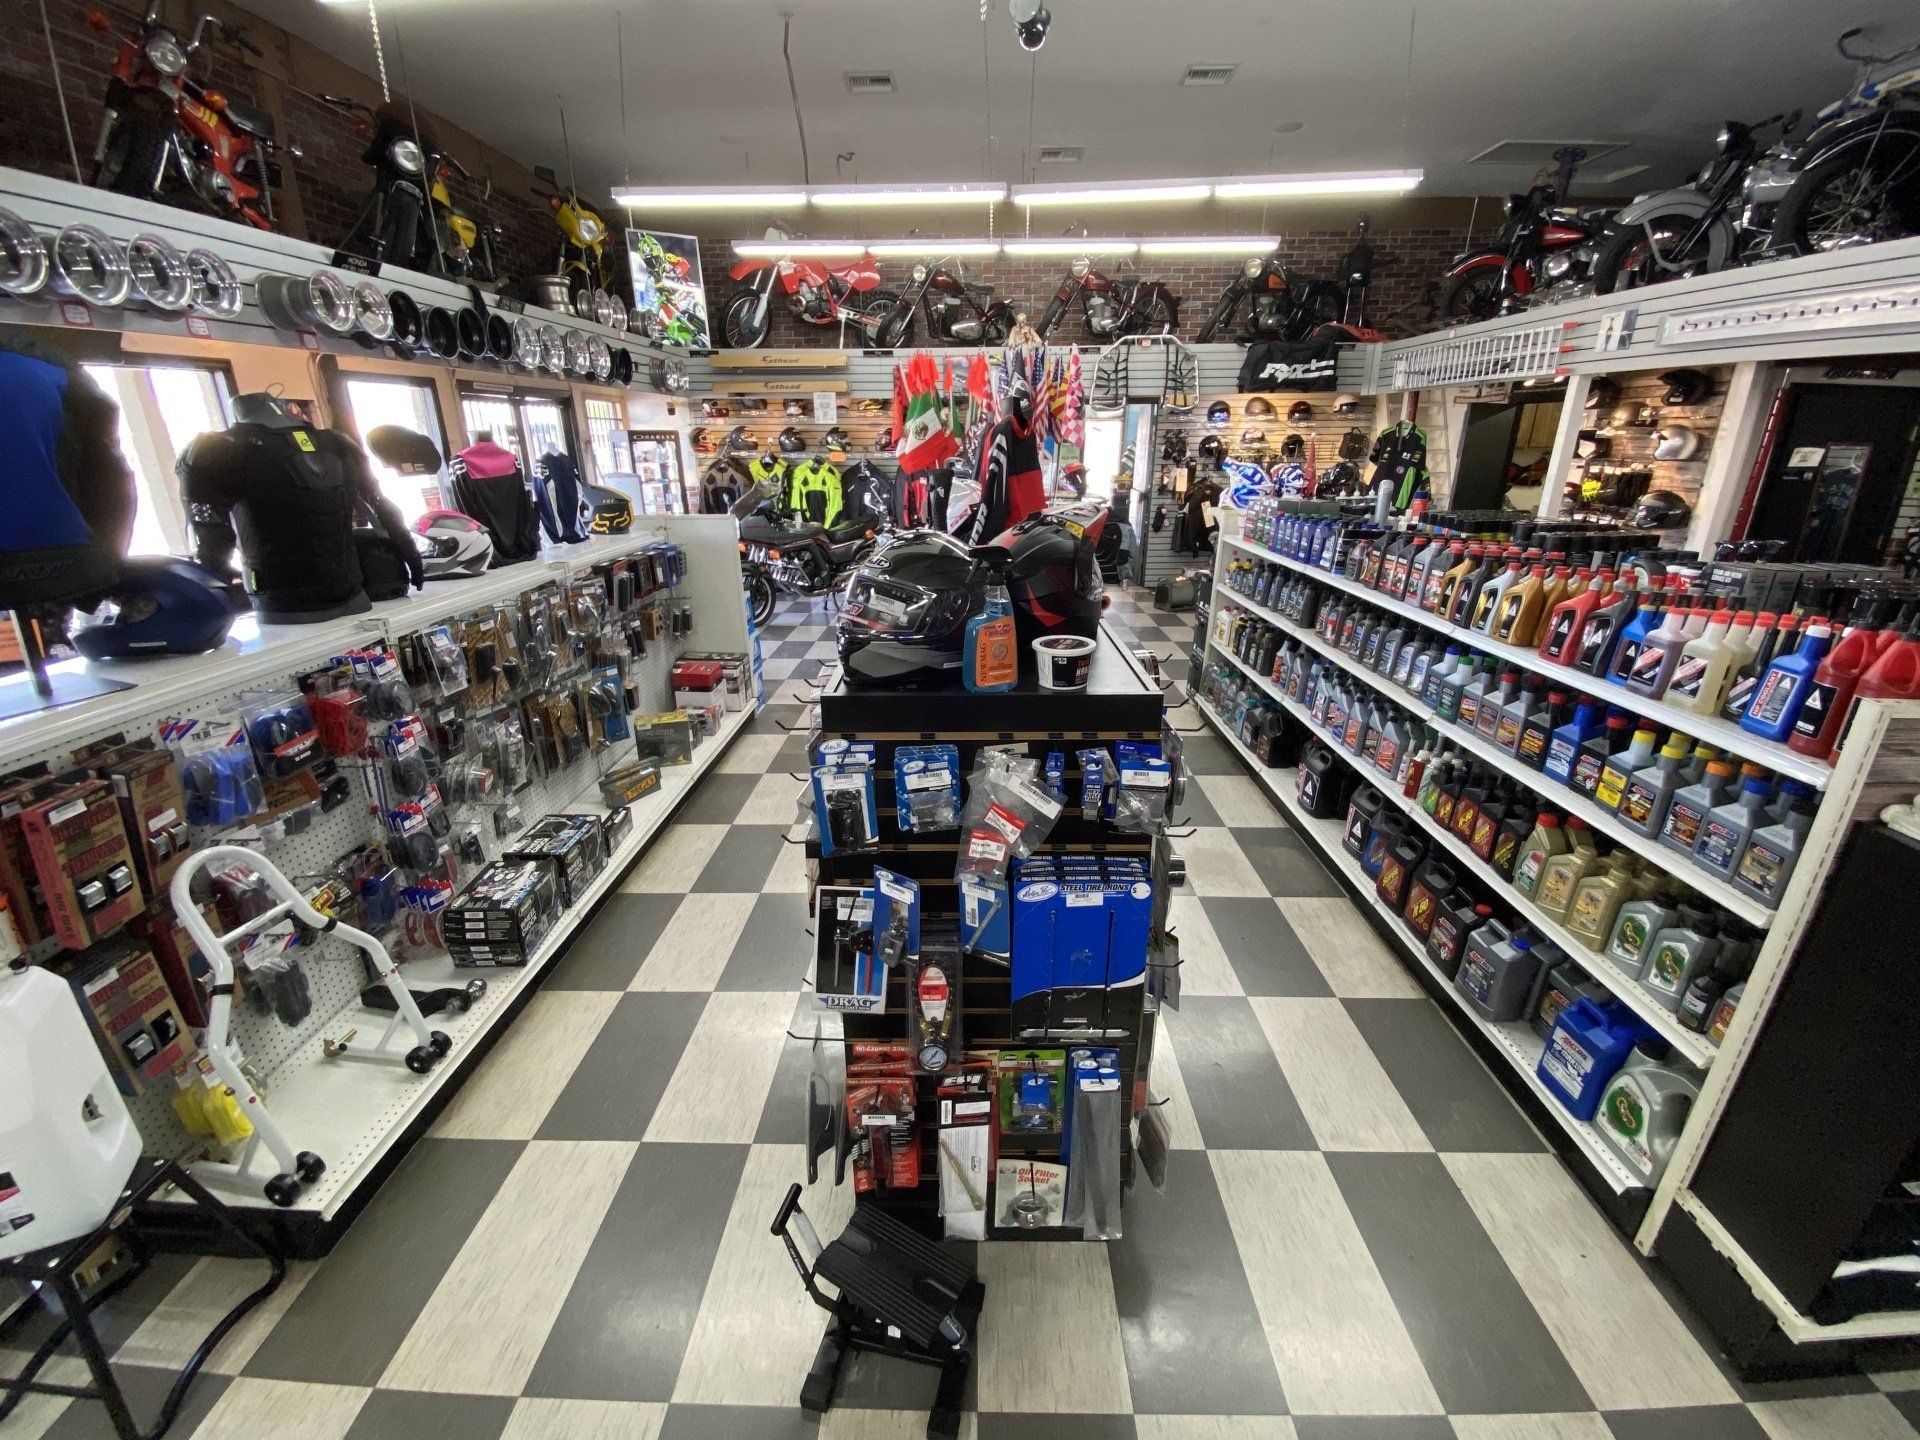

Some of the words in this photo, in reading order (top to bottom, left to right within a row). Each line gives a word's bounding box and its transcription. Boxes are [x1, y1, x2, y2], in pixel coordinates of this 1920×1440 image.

[1758, 671, 1779, 704] COOLANT
[1664, 814, 1676, 835] DIRT
[826, 996, 870, 1007] DRAG
[1559, 1036, 1588, 1061] AMSOIL
[1018, 1168, 1032, 1176] Oil
[1034, 1169, 1059, 1178] Filter
[1018, 1175, 1051, 1184] Soket
